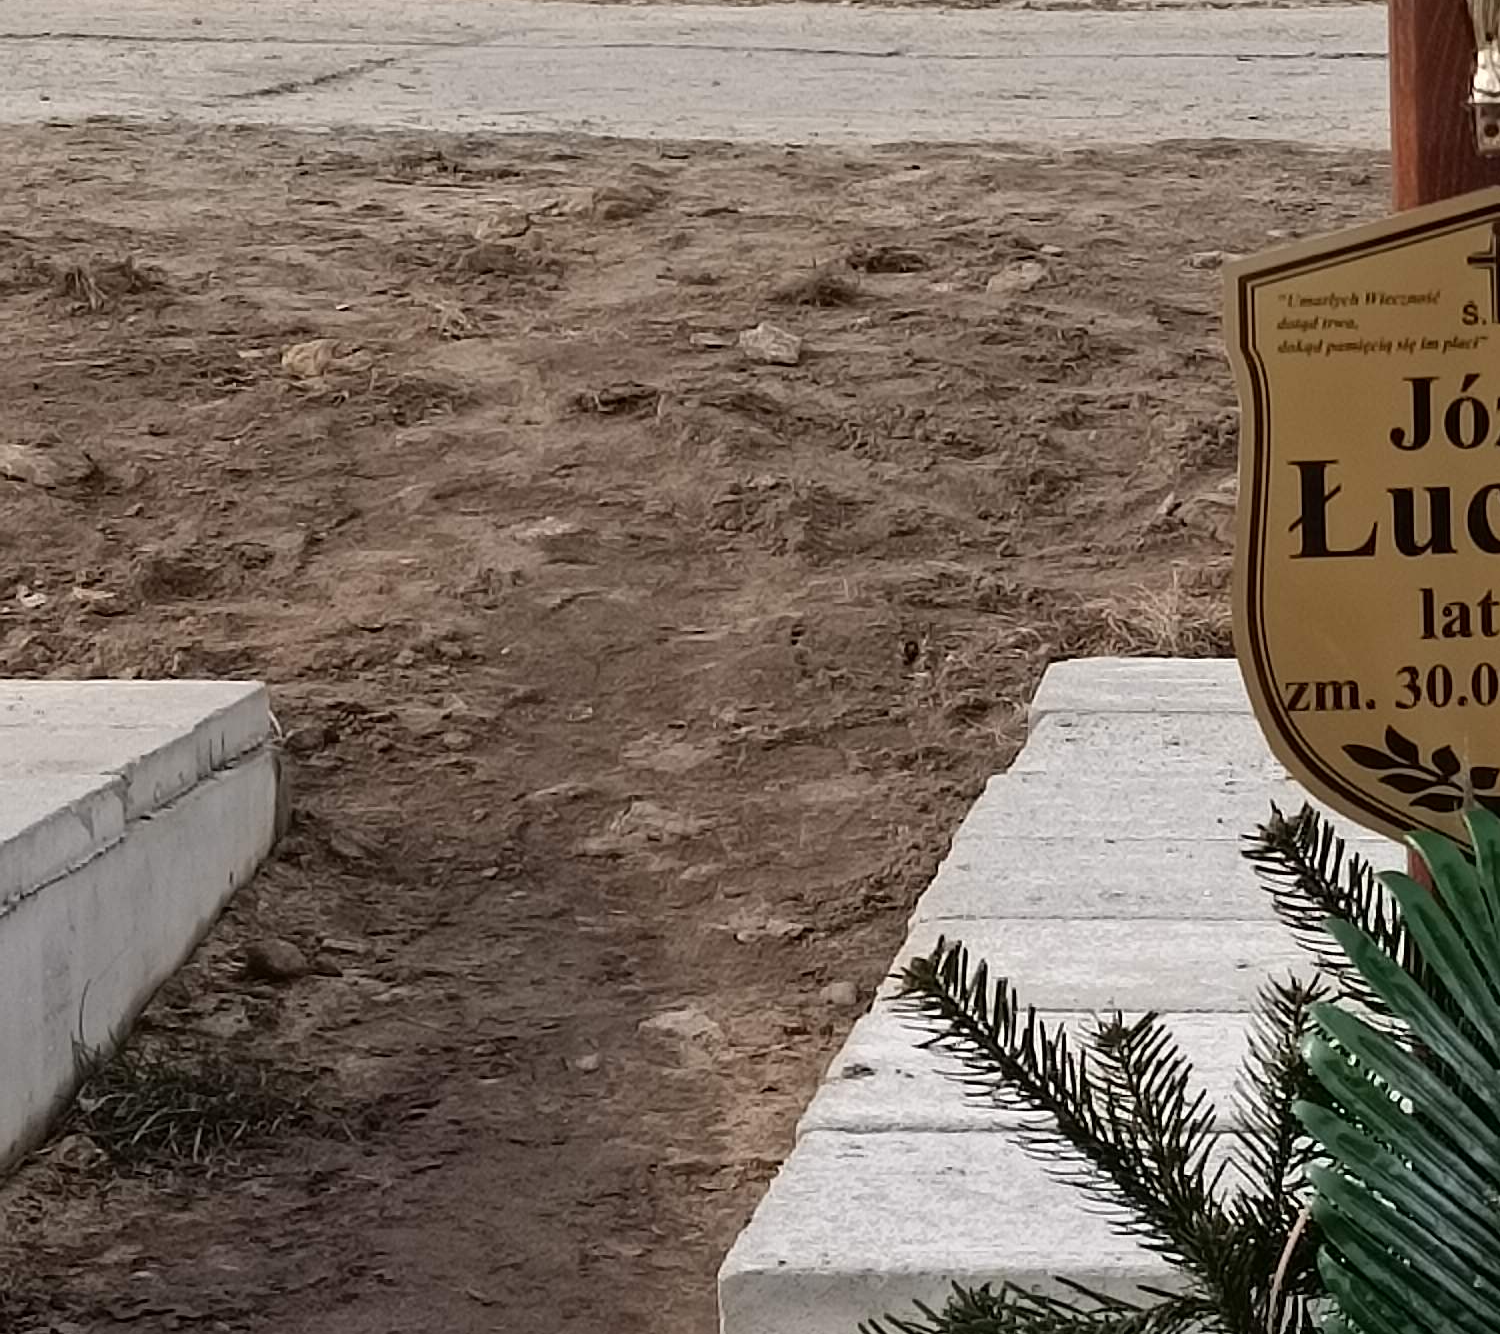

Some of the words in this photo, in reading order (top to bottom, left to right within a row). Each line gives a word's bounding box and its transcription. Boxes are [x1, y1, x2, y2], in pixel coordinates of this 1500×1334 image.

[1461, 300, 1487, 326] Ś.
[1418, 587, 1500, 640] lat
[1285, 679, 1377, 712] zm.
